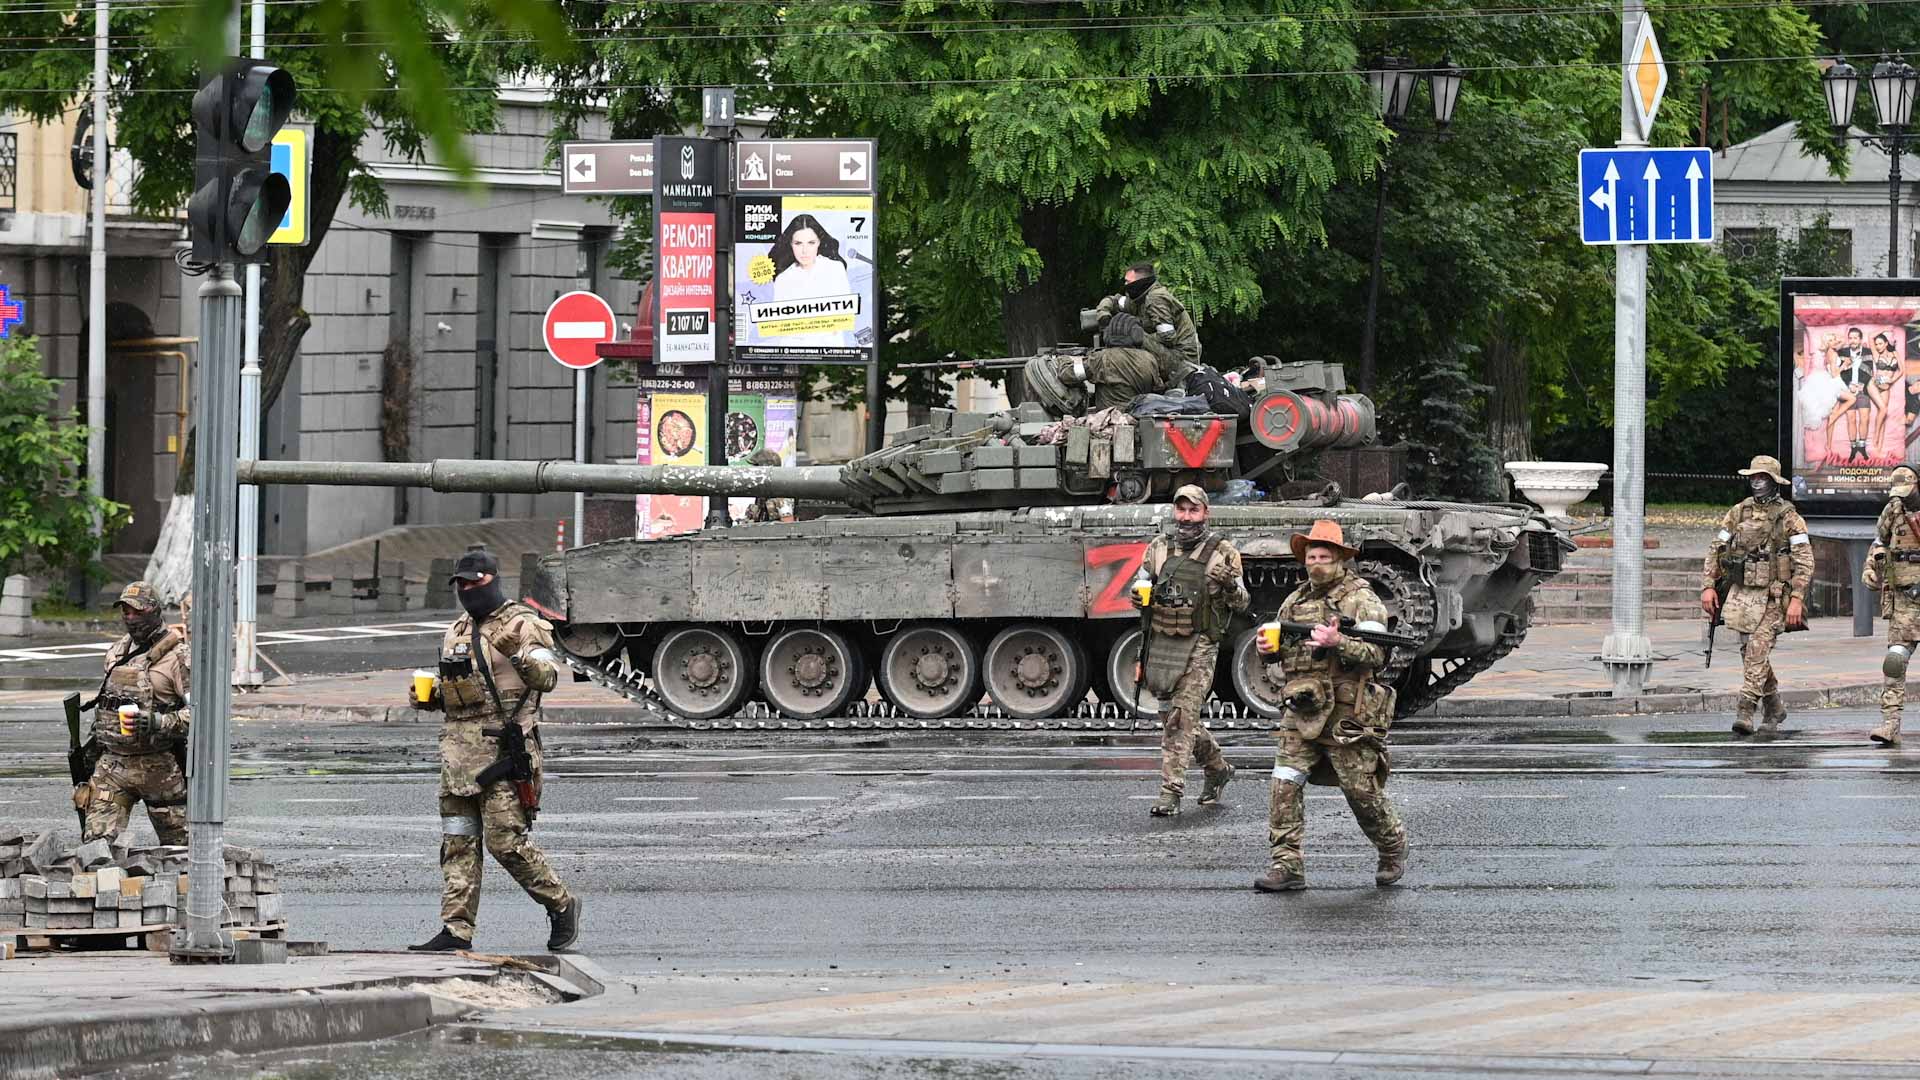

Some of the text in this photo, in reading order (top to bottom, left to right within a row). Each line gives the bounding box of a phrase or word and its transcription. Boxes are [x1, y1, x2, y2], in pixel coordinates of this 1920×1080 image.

[663, 184, 712, 197] MANHATTAN
[745, 204, 772, 213] РУКИ
[744, 213, 778, 223] ВВЕРХ
[850, 217, 866, 233] 7
[744, 222, 765, 231] БАР
[663, 224, 712, 248] РЕМОНТ
[663, 255, 712, 279] КВАРТИР
[752, 268, 772, 279] 20:00
[757, 300, 854, 318] ИНФИНИТИ
[691, 315, 705, 331] 167
[658, 364, 682, 375] 40/2
[1163, 418, 1224, 468] V
[1840, 467, 1883, 476] ПОДОЖДУТ
[1087, 541, 1149, 614] Z
